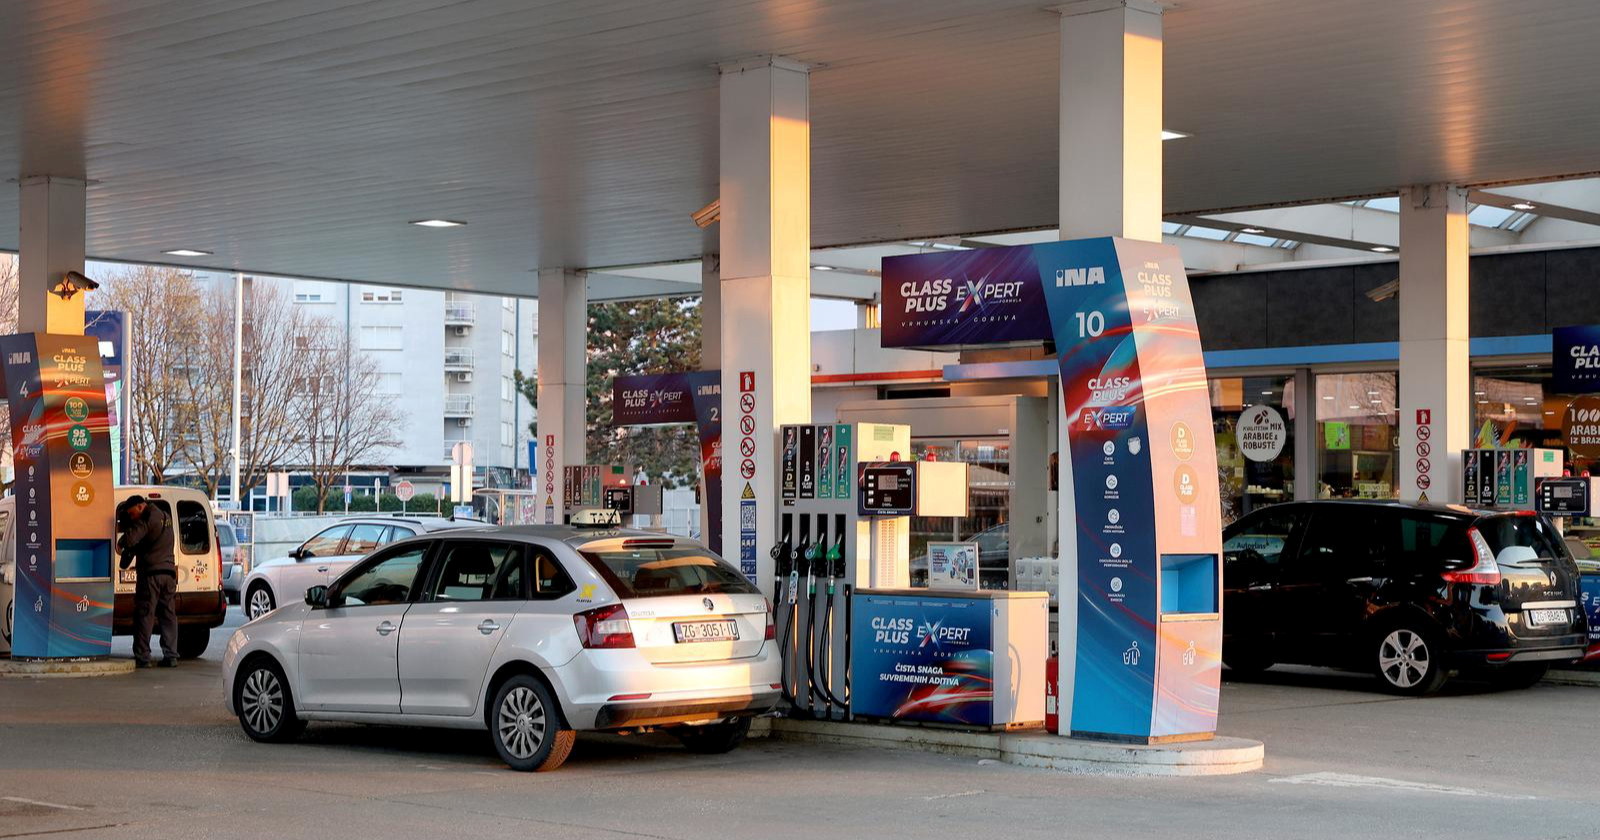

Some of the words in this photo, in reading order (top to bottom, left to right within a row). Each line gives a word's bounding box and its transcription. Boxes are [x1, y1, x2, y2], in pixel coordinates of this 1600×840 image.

[1137, 272, 1173, 286] CLASS
[900, 279, 953, 297] CLASS
[955, 278, 1024, 313] EXPERT
[1143, 284, 1172, 297] PLUS
[905, 296, 947, 313] PLUS
[901, 318, 960, 327] VRHUNSKA
[973, 314, 1017, 323] GORIVA
[1076, 311, 1105, 339] 10
[1570, 345, 1600, 357] CLA
[53, 354, 86, 364] CLASS
[57, 363, 84, 372] PLUS
[19, 381, 29, 398] 4
[1087, 377, 1130, 390] CLASS
[622, 389, 649, 399] CLASS
[1092, 389, 1126, 401] PLUS
[624, 399, 646, 408] PLUS
[710, 407, 719, 422] 2
[1084, 408, 1129, 431] EXPERT
[72, 429, 86, 437] 95
[1177, 427, 1186, 439] D
[1243, 441, 1276, 450] ROBUSTE
[77, 456, 84, 464] D
[786, 473, 793, 481] D
[804, 474, 811, 482] D
[1182, 473, 1190, 484] D
[79, 486, 87, 494] D
[682, 625, 696, 638] ZG
[871, 617, 914, 632] CLASS
[916, 621, 971, 648] EXPERT
[875, 630, 909, 645] PLUS
[895, 662, 916, 673] ČISTA
[917, 665, 944, 676] SNAGA
[879, 672, 927, 684] SUVREMENIH
[928, 677, 960, 687] ADITIVA
